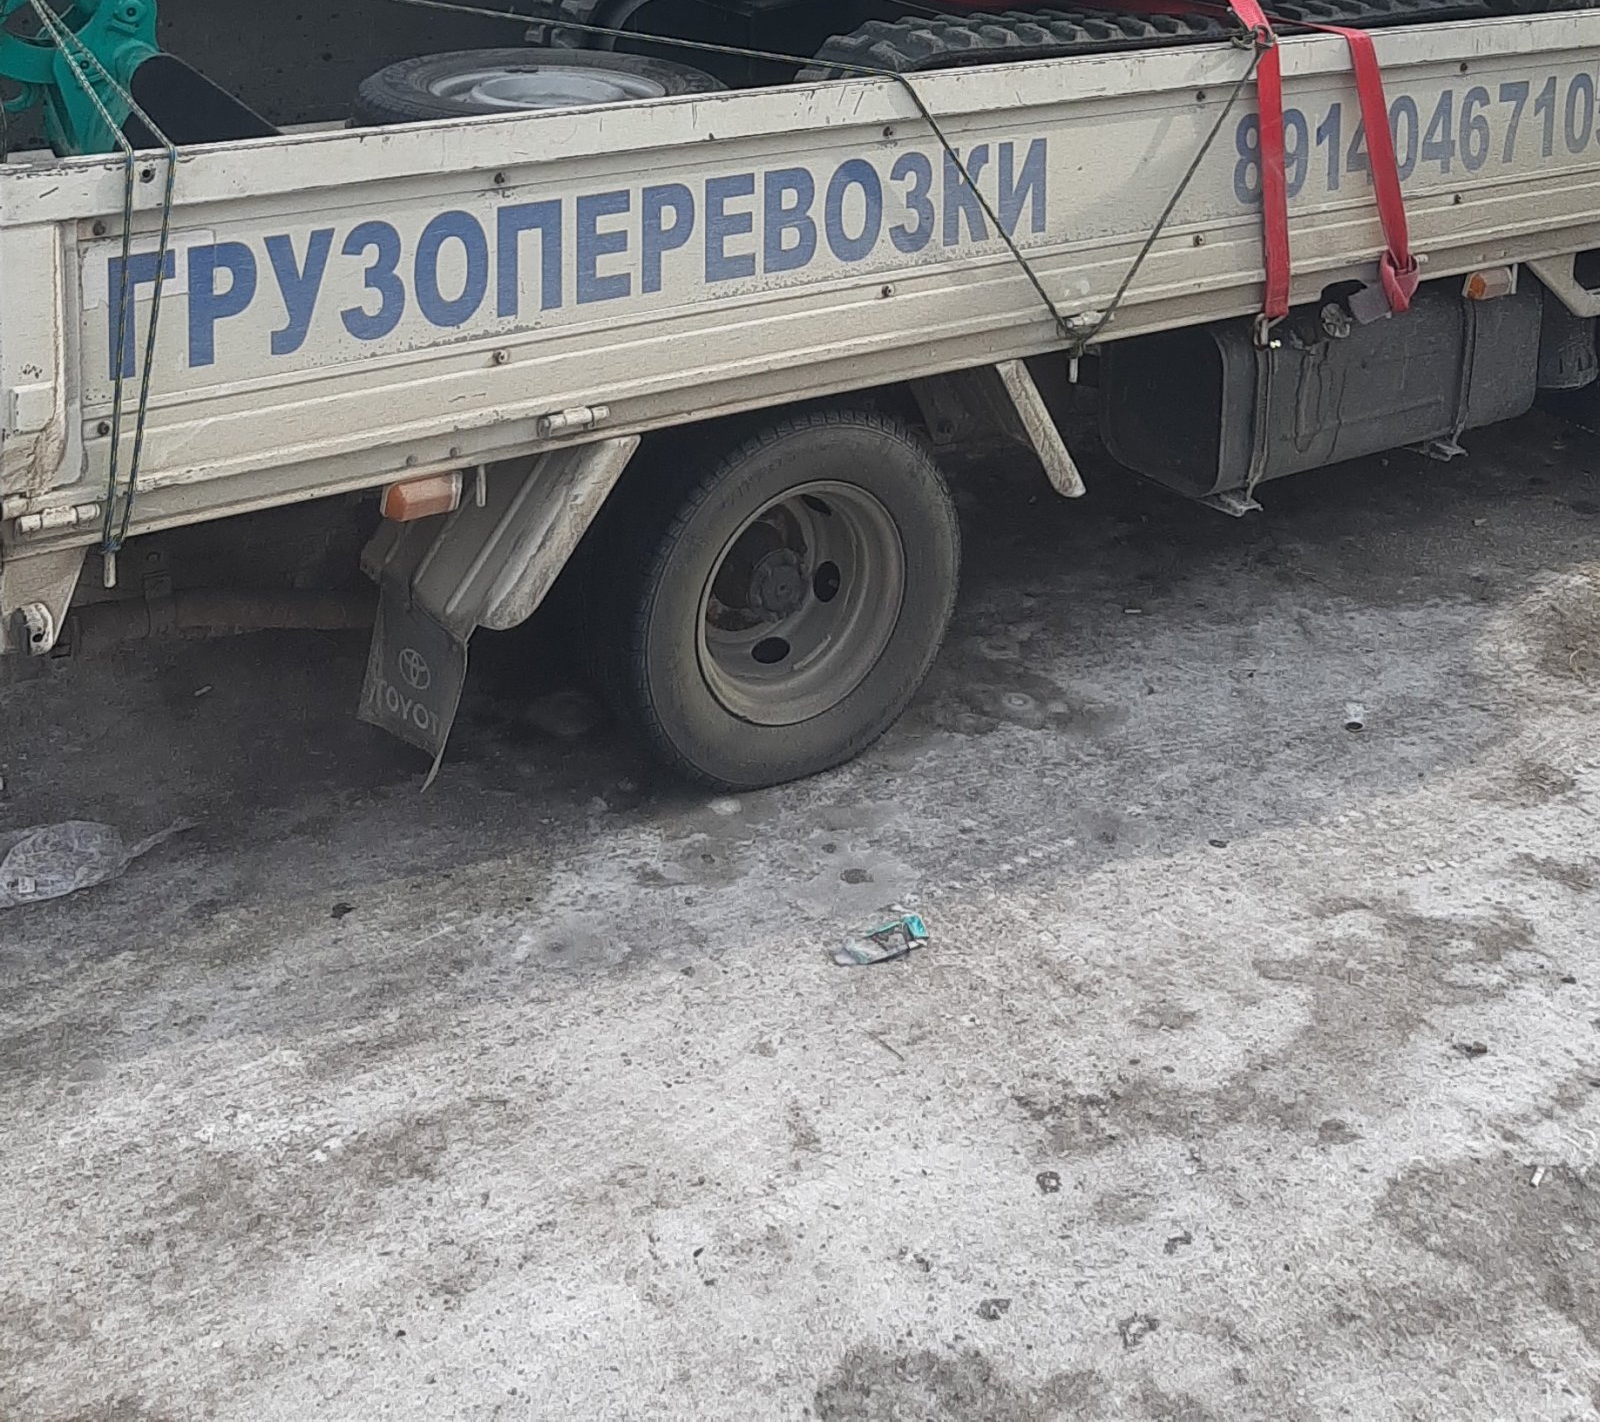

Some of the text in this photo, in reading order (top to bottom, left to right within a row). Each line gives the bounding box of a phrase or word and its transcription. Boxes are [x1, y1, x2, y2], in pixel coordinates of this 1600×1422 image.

[1233, 72, 1600, 205] 8914046710
[107, 138, 1047, 380] ГРУЗОПЕРЕВОЗКИ
[374, 678, 446, 742] TOYOT
